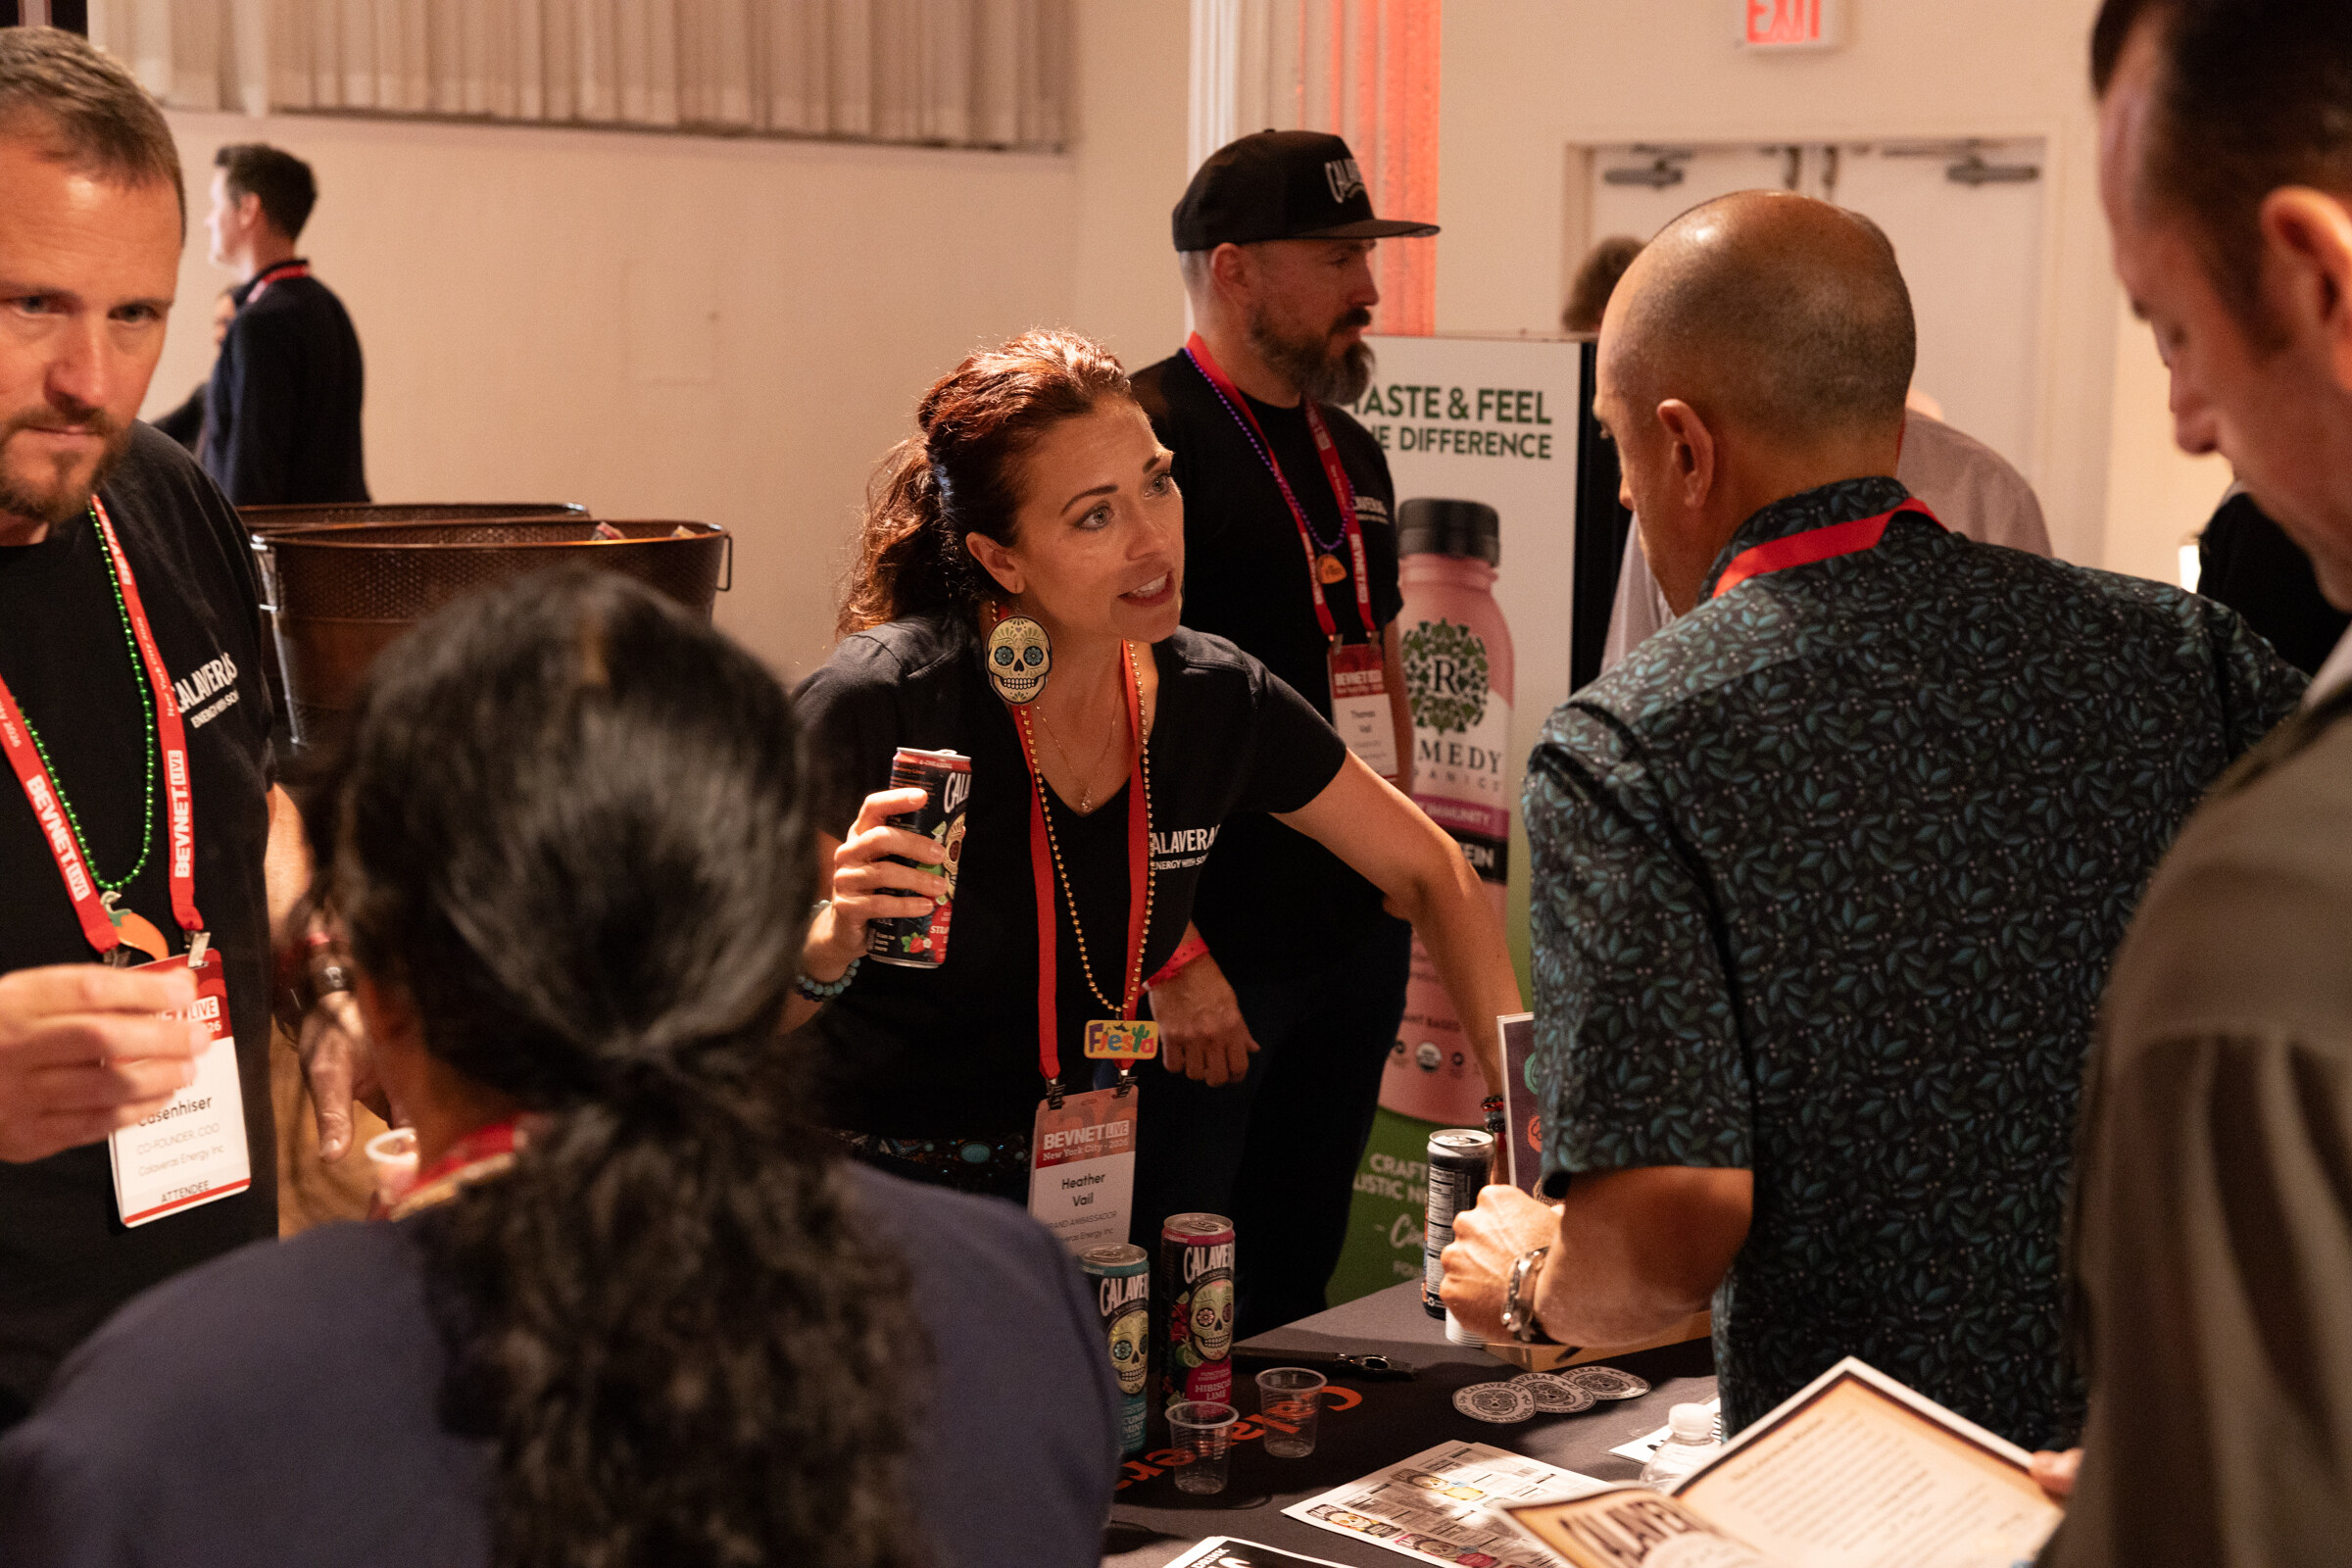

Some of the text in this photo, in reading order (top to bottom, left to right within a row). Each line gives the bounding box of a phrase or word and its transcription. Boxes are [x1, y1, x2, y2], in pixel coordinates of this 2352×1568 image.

[1447, 386, 1470, 421] &
[1477, 389, 1552, 425] FEEL
[1399, 426, 1552, 460] DIFFERENCE
[1434, 659, 1458, 696] R
[169, 751, 186, 784] LIVE
[1417, 739, 1501, 774] MEDY
[66, 862, 90, 900] LIVE
[189, 997, 220, 1022] LIVE
[1088, 1022, 1155, 1054] Fiesta
[1043, 1151, 1062, 1161] New
[1064, 1147, 1083, 1157] York
[1084, 1144, 1103, 1153] City
[161, 1180, 210, 1203] ATTENDEE
[1061, 1173, 1106, 1190] Heather
[1072, 1192, 1095, 1206] Vail
[1206, 1390, 1227, 1400] LIME
